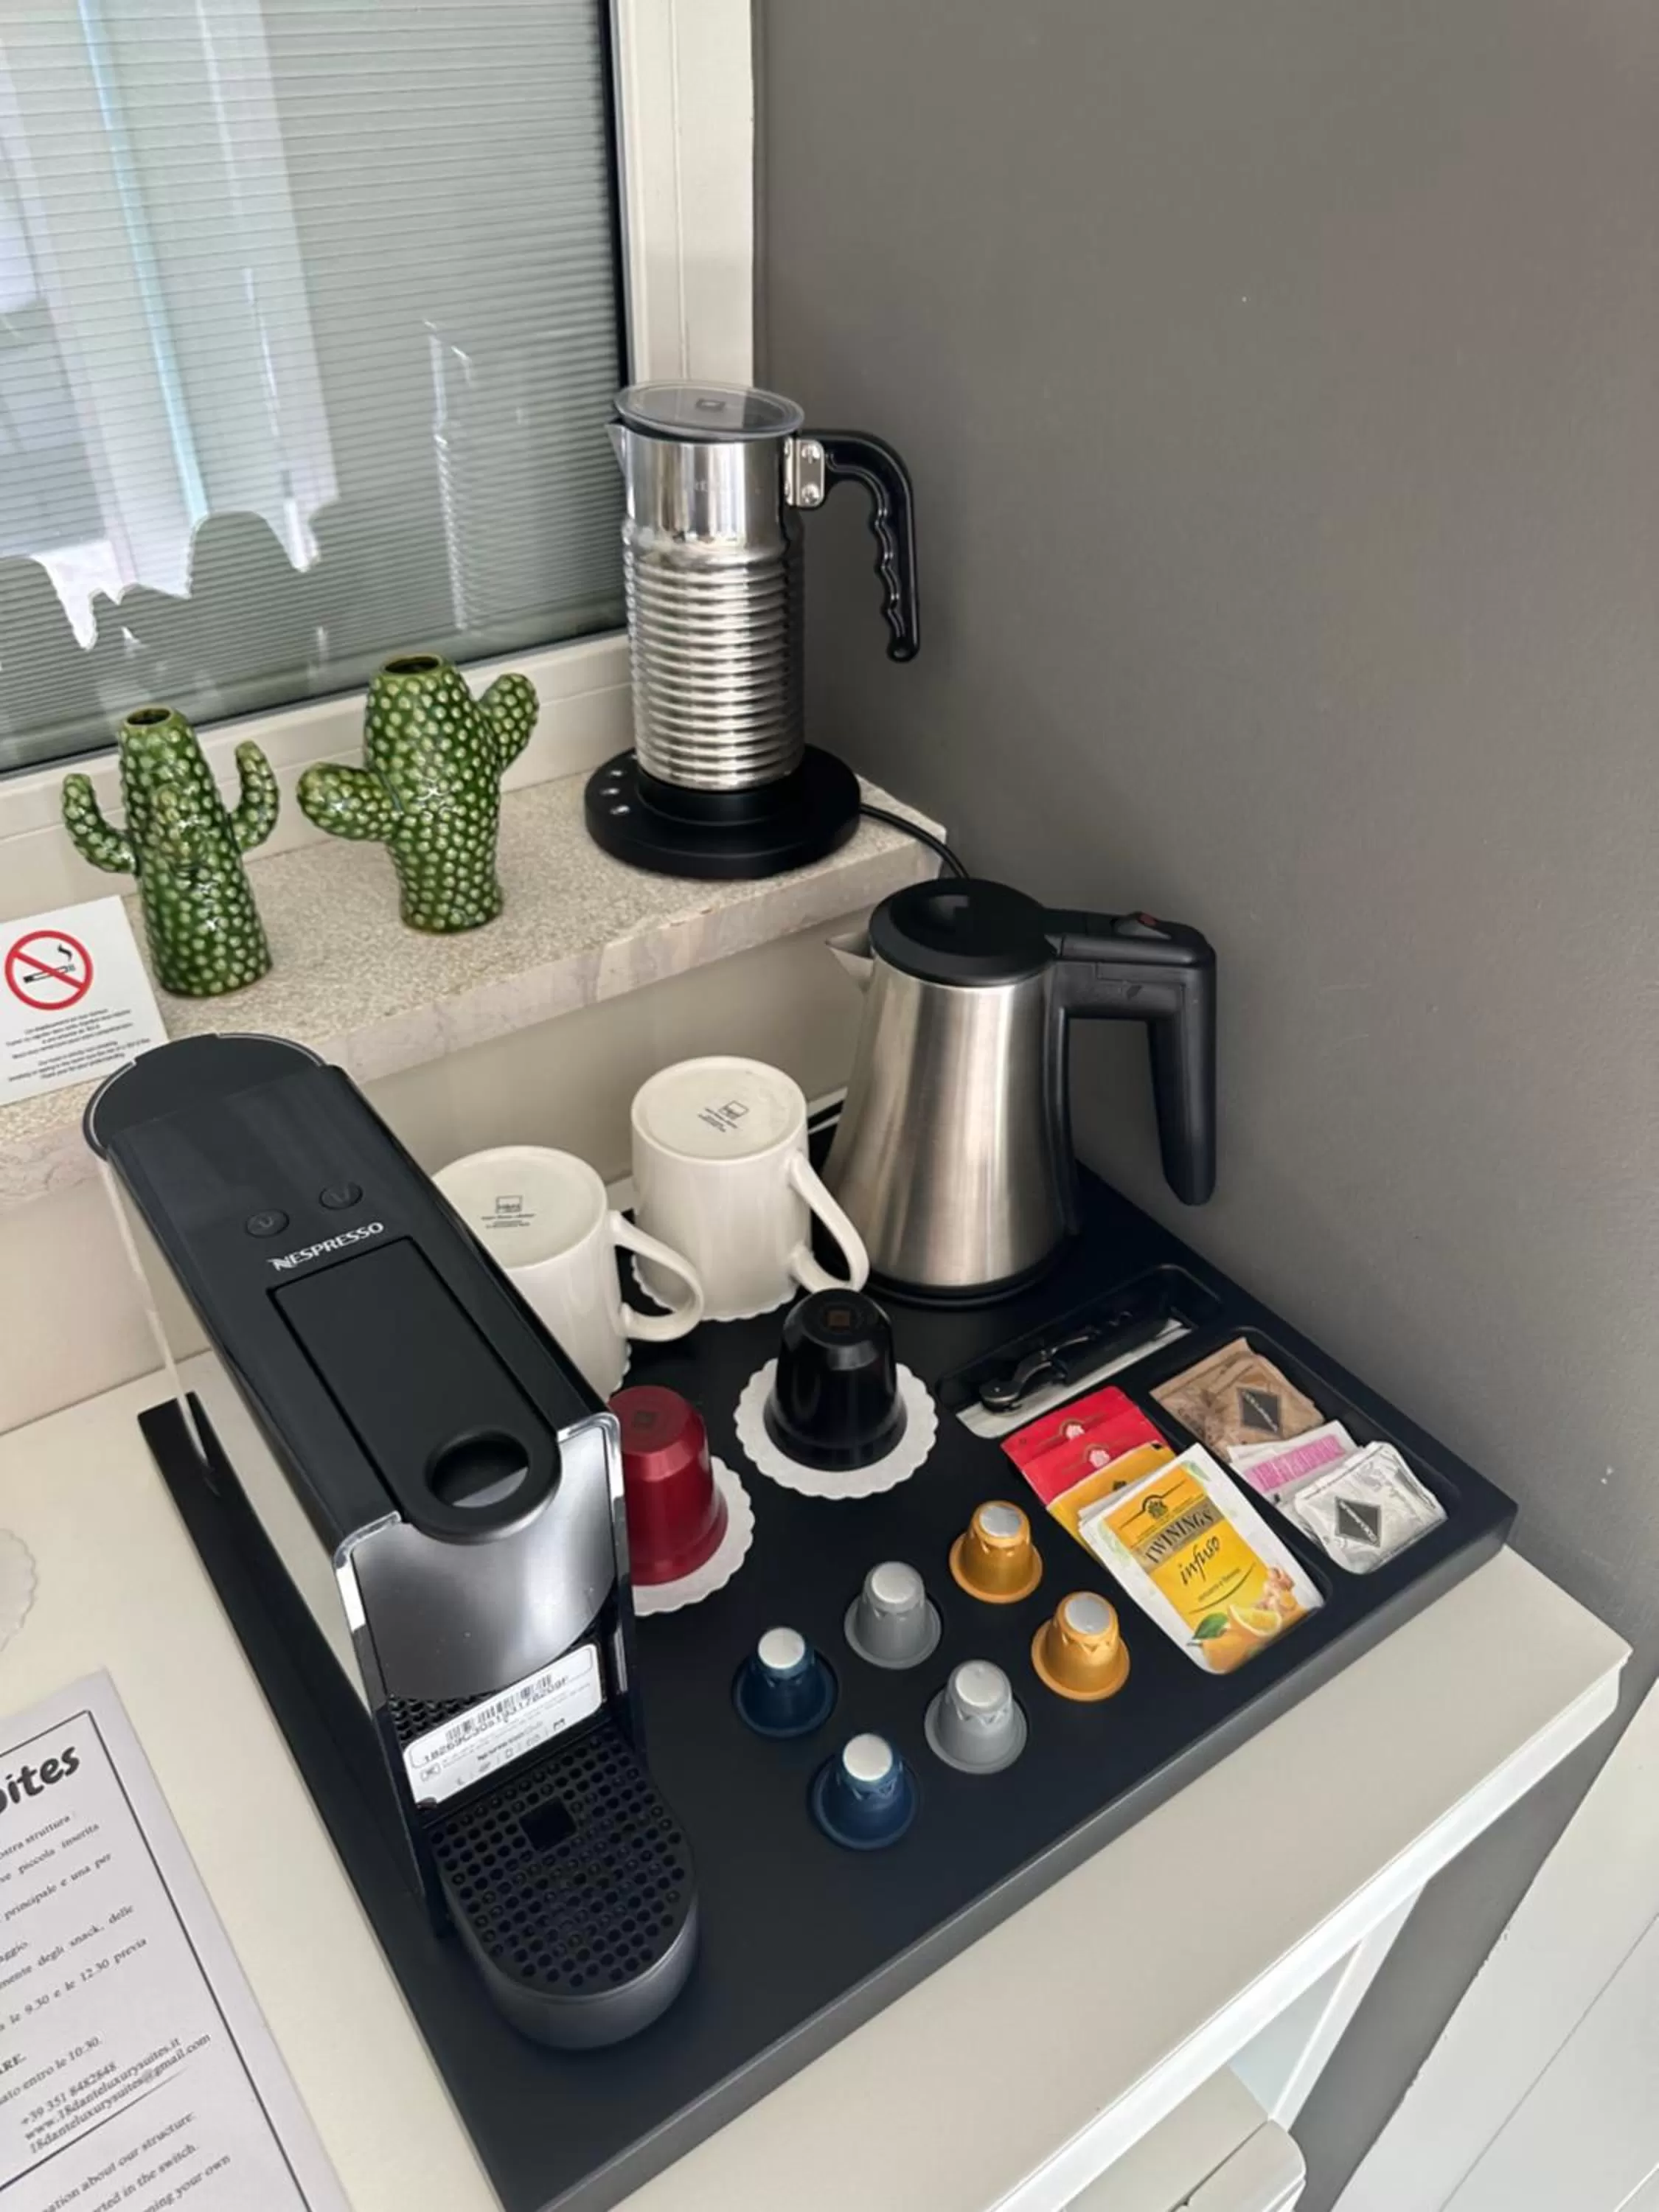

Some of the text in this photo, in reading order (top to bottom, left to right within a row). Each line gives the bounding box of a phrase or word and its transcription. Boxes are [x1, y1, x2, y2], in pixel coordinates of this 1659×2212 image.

[266, 1222, 383, 1271] NESPRESSO
[1144, 1509, 1215, 1563] TWININGS
[1180, 1535, 1220, 1586] infuso
